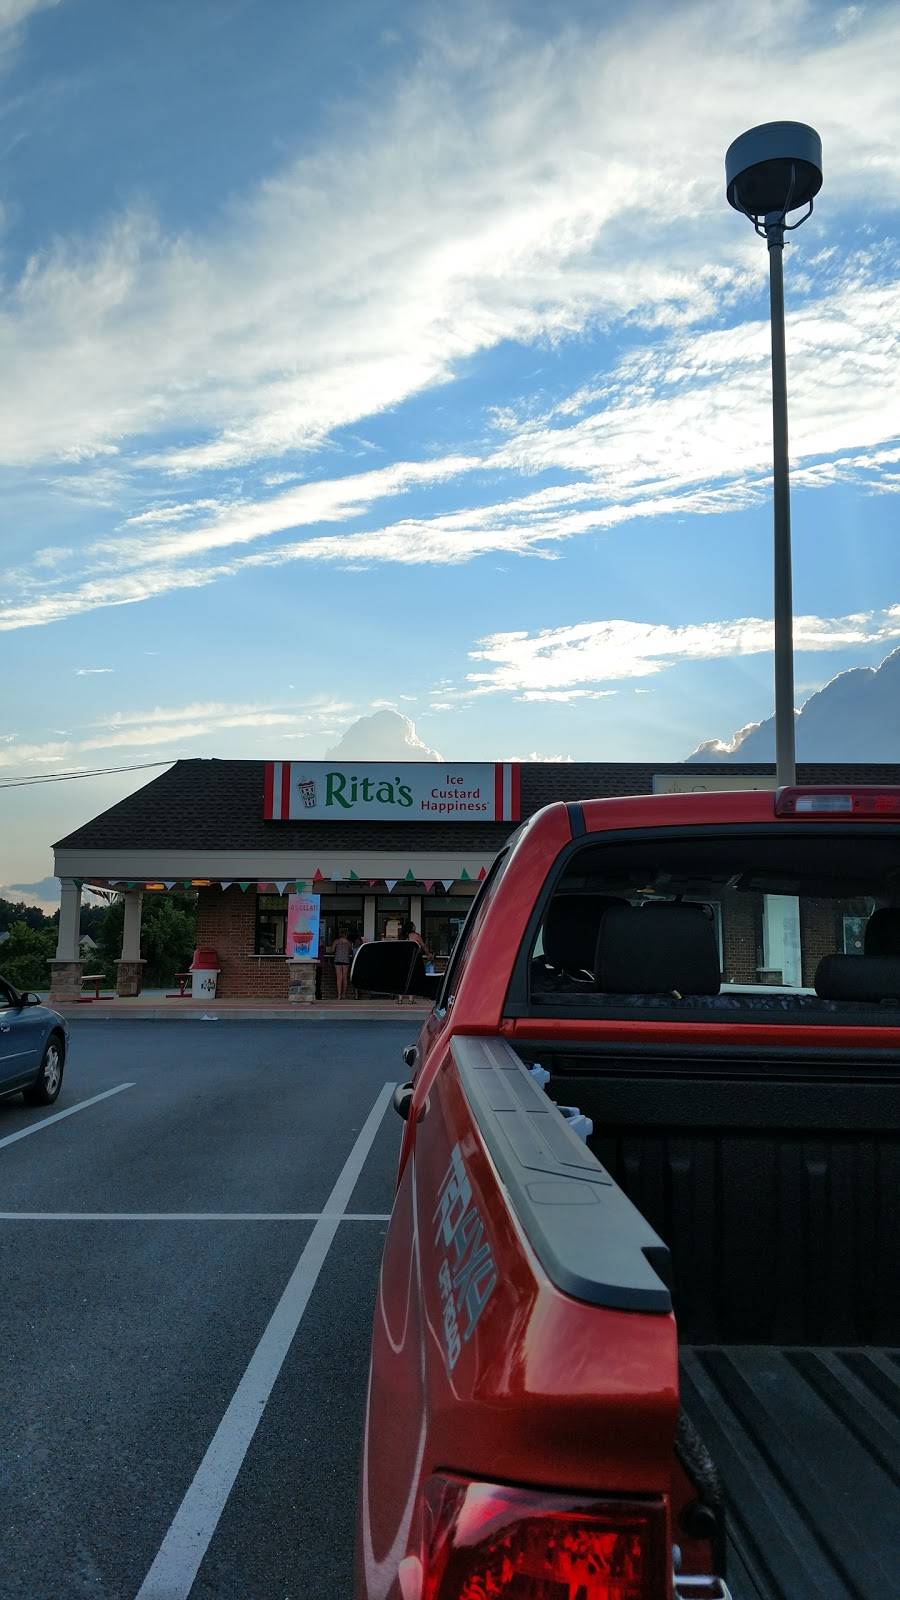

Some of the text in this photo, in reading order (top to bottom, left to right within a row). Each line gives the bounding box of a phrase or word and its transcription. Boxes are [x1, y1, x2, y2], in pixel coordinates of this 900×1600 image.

[325, 772, 413, 808] Rita's
[446, 774, 464, 785] Ice
[431, 788, 480, 799] Custard
[421, 800, 487, 814] Happiness
[432, 1141, 473, 1247] TRD
[442, 1295, 461, 1371] ROAD
